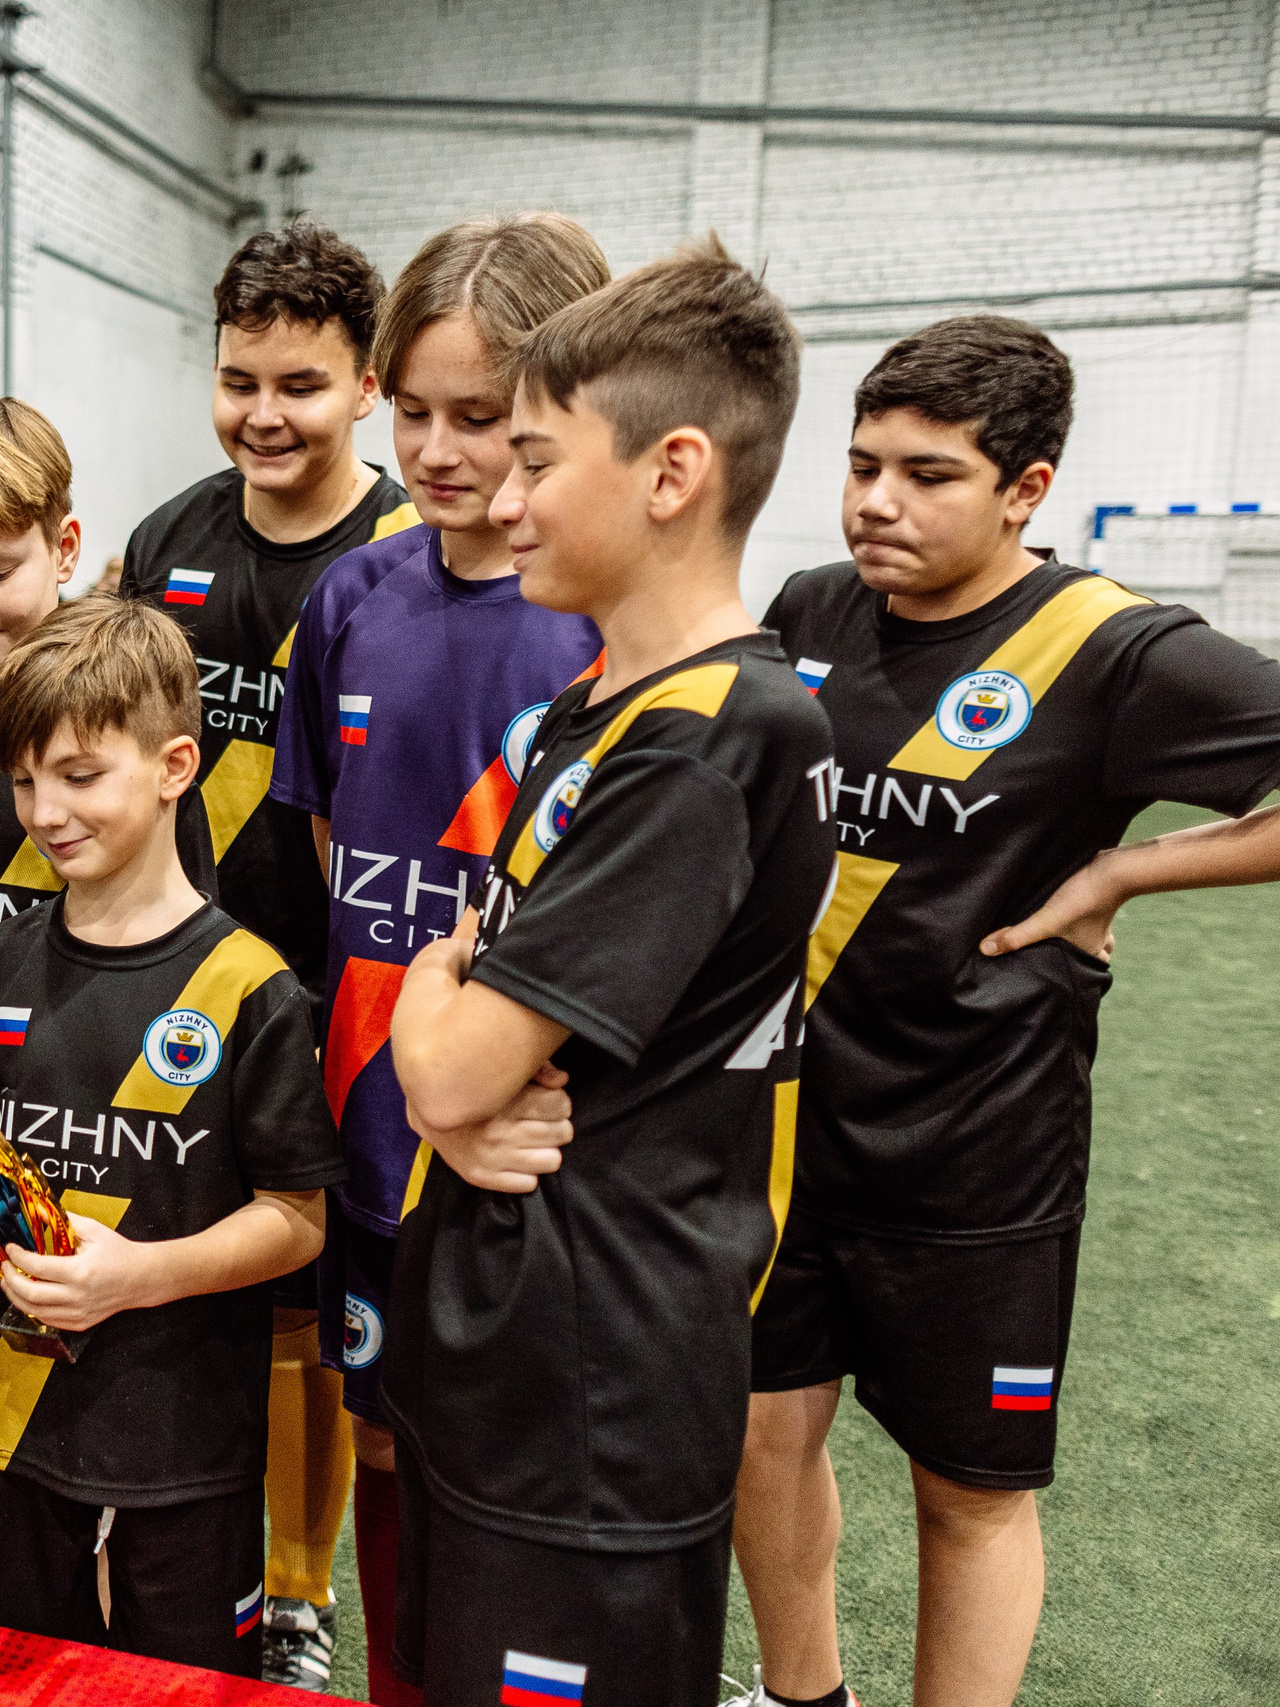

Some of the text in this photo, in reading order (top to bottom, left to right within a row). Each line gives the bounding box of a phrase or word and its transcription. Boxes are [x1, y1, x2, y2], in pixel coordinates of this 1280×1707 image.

[969, 675, 1016, 691] NIZHNY
[208, 709, 269, 736] CITY
[957, 735, 985, 746] CITY
[836, 820, 876, 847] TY
[328, 841, 468, 925] IZH
[166, 1014, 208, 1030] NIZHNY
[168, 1071, 191, 1082] CITY
[40, 1157, 110, 1185] CITY
